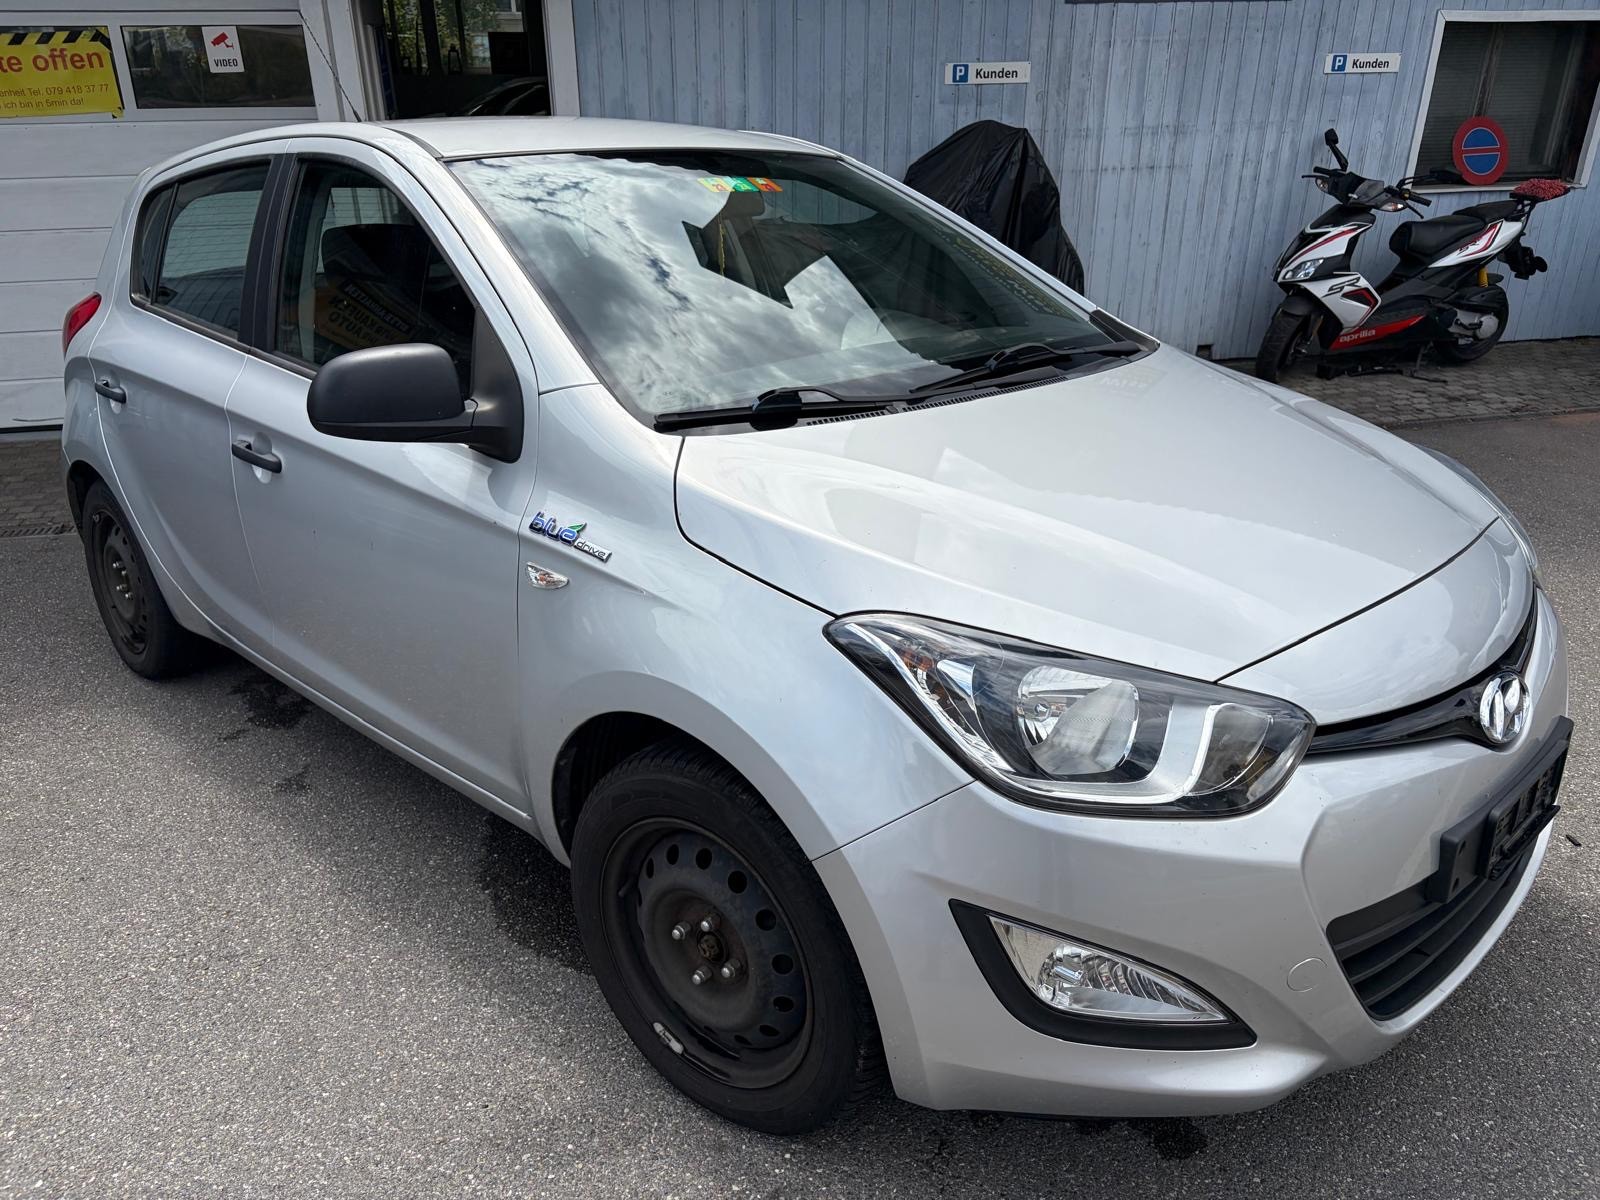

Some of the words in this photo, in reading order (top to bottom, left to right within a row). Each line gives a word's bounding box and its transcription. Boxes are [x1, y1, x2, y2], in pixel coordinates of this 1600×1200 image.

[32, 48, 104, 72] offen
[213, 58, 239, 68] VIDEO
[1351, 58, 1390, 69] Kunden
[975, 67, 1018, 79] Kunden
[27, 87, 44, 97] Tel.
[46, 86, 63, 96] 079
[65, 85, 83, 95] 418
[86, 84, 96, 93] 37
[98, 83, 109, 92] 77
[4, 100, 17, 109] ich
[19, 99, 33, 109] bin
[35, 100, 43, 108] in
[45, 98, 68, 108] 5min
[1321, 276, 1361, 298] SR
[1339, 328, 1376, 342] aprilia
[529, 511, 578, 546] blue
[576, 540, 607, 560] drive
